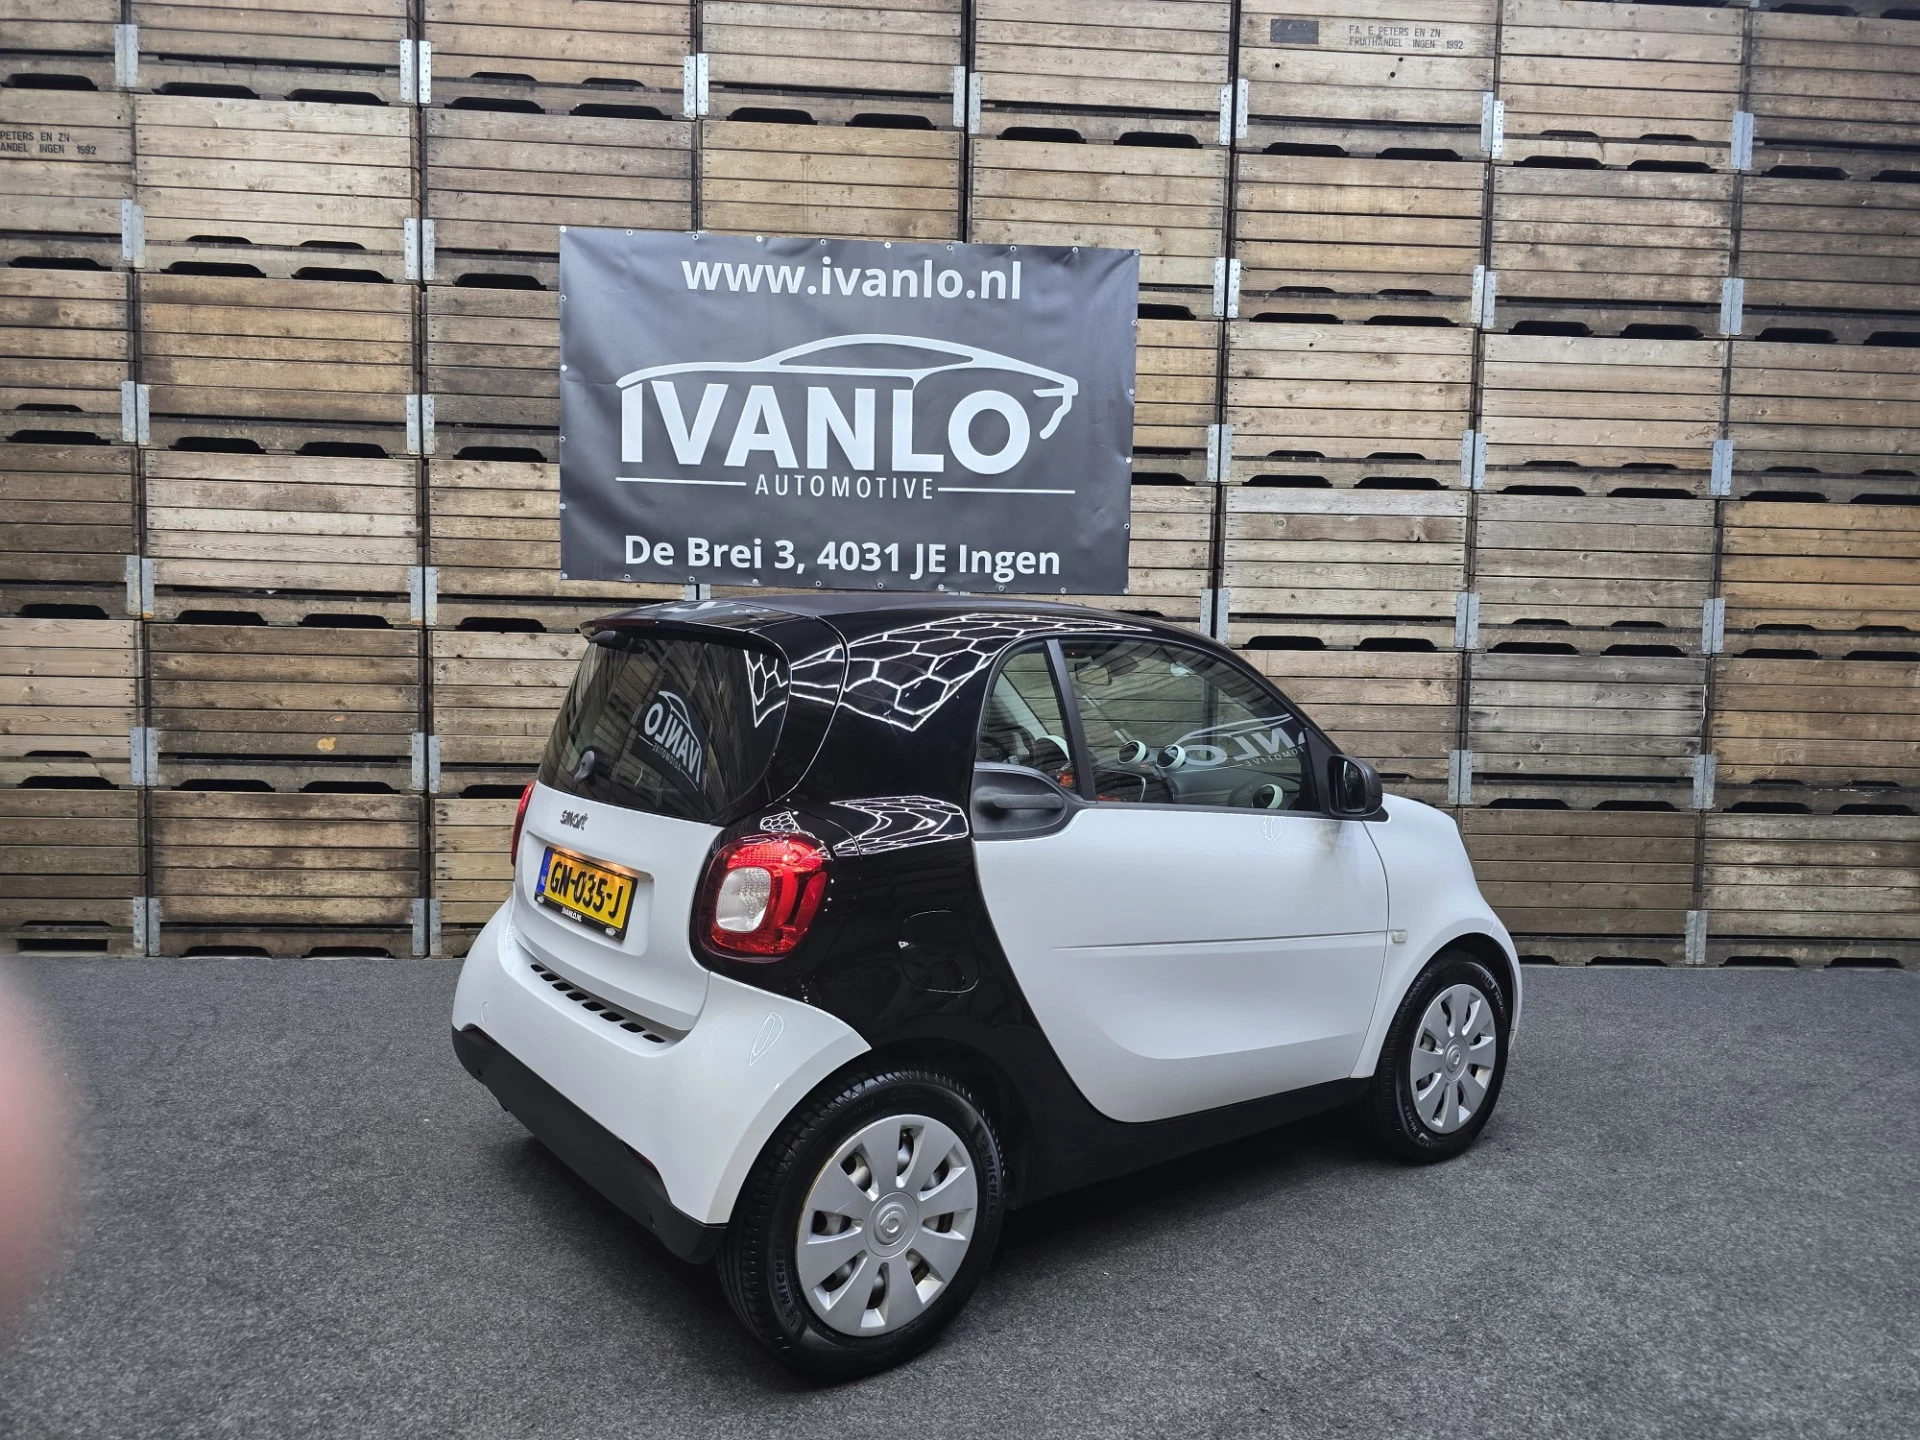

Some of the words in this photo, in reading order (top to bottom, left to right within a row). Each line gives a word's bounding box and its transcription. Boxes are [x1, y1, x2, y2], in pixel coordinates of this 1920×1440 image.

[1349, 37, 1403, 48] FRUITHANDEL
[1412, 39, 1436, 49] INGEN
[1446, 40, 1464, 50] 1992
[1378, 26, 1409, 37] PETERS
[1414, 28, 1426, 37] EN
[1430, 28, 1441, 38] ZN
[0, 130, 34, 141] PETERS
[40, 132, 53, 142] EN
[58, 132, 70, 143] ZN
[0, 142, 29, 152] ANDEL
[39, 144, 65, 154] INGEN
[76, 145, 97, 155] 1992
[681, 256, 1022, 300] www.ivanlo.nl
[621, 380, 1031, 475] IVANLO
[755, 473, 934, 500] AUTOMOTIVE
[625, 535, 675, 567] De
[688, 537, 762, 569] Brei
[775, 539, 806, 575] 3,
[817, 541, 899, 573] 4031
[910, 544, 947, 580] JE
[960, 544, 1061, 583] Ingen
[560, 810, 588, 831] smart
[550, 861, 624, 919] GN-035-J
